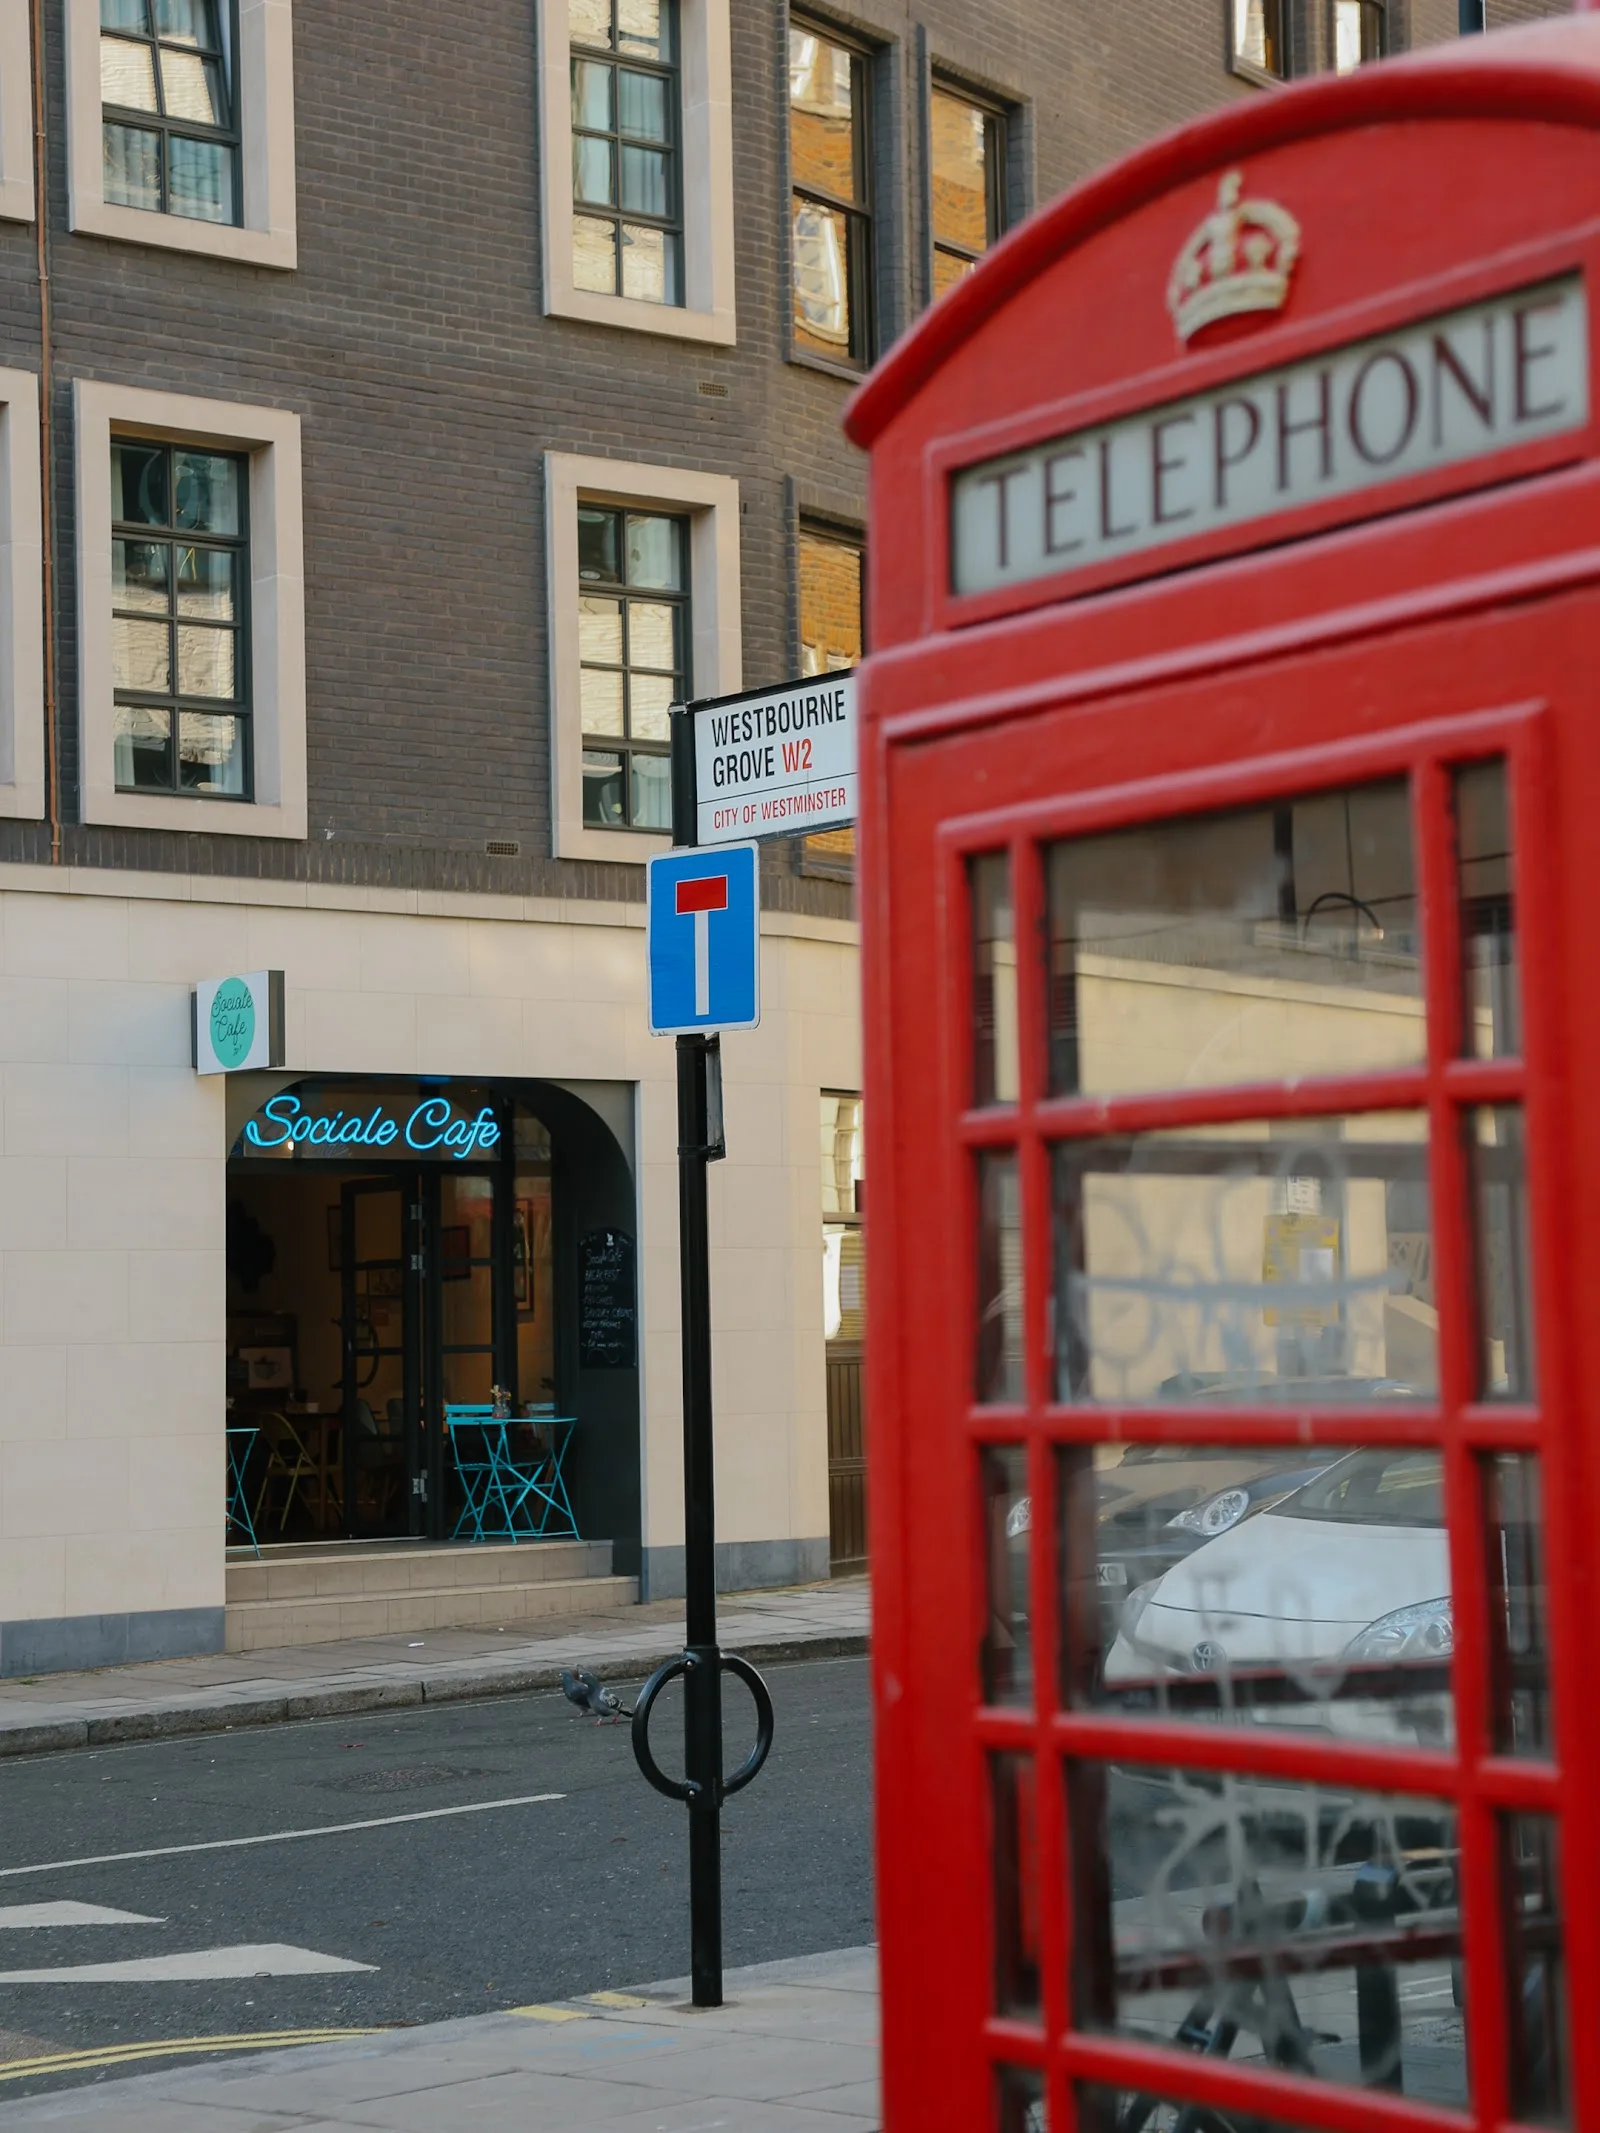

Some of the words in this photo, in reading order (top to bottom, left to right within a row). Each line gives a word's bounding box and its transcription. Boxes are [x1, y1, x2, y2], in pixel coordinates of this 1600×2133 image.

[975, 304, 1567, 569] TELEPHONE
[711, 689, 846, 747] WESTBOURNE
[713, 745, 775, 787] GROVE
[781, 738, 813, 773] W2
[714, 807, 738, 829] CITY
[742, 804, 757, 824] OF
[761, 787, 846, 820] WESTMINSTER
[211, 987, 253, 1018] Sociale
[245, 1095, 399, 1147] Sociale
[404, 1097, 501, 1159] Cafe
